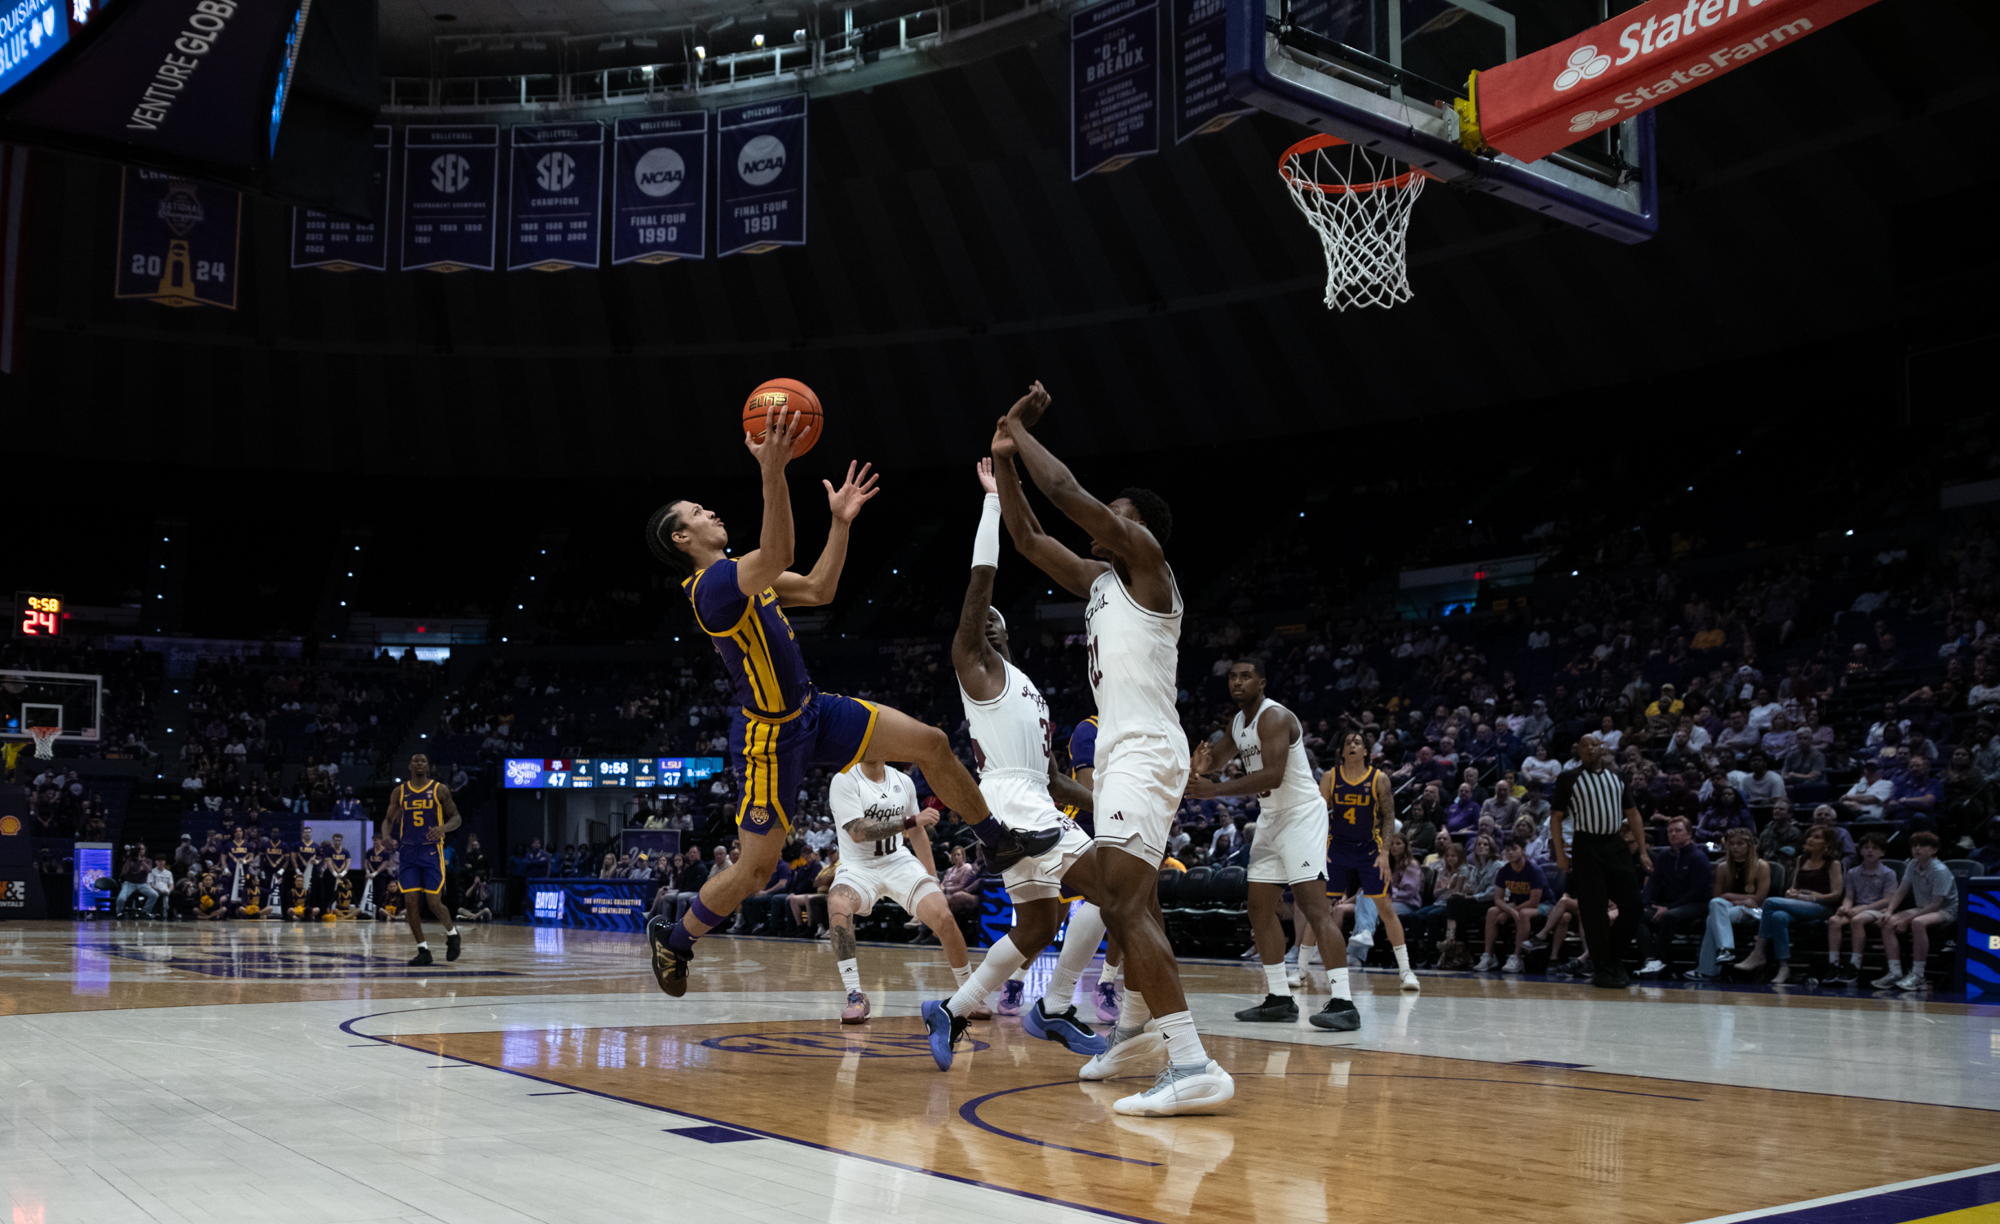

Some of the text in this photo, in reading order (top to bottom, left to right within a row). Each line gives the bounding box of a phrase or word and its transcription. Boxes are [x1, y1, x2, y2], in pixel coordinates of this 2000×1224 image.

[1086, 46, 1144, 83] BREAUX
[126, 52, 199, 130] VENTURE
[742, 105, 782, 120] VOLLEYBALL
[640, 120, 681, 131] VOLLEYBALL
[431, 132, 472, 140] VOLLEYBALL
[537, 129, 578, 139] VOLLEYBALL
[430, 153, 470, 193] SEC
[536, 151, 576, 191] SEC
[743, 156, 784, 175] NCAA
[640, 170, 683, 185] NCAA
[531, 197, 579, 208] CHAMPIONS
[734, 199, 788, 218] FINAL FOUR
[630, 212, 686, 227] FINAL FOUR
[744, 214, 777, 234] 1991
[638, 226, 677, 244] 1990
[131, 254, 226, 283] 20 24
[28, 597, 59, 612] 9:58
[23, 610, 58, 635] 24
[579, 764, 587, 775] 4
[600, 762, 629, 774] 9:58
[641, 764, 649, 775] 4
[662, 761, 682, 769] LSU
[548, 772, 567, 787] 47
[619, 777, 626, 786] 2
[663, 772, 681, 787] 37
[404, 799, 433, 810] LSU
[1334, 793, 1370, 806] LSU
[413, 811, 424, 827] 5
[1343, 807, 1356, 825] 4
[535, 891, 559, 909] BAYOU
